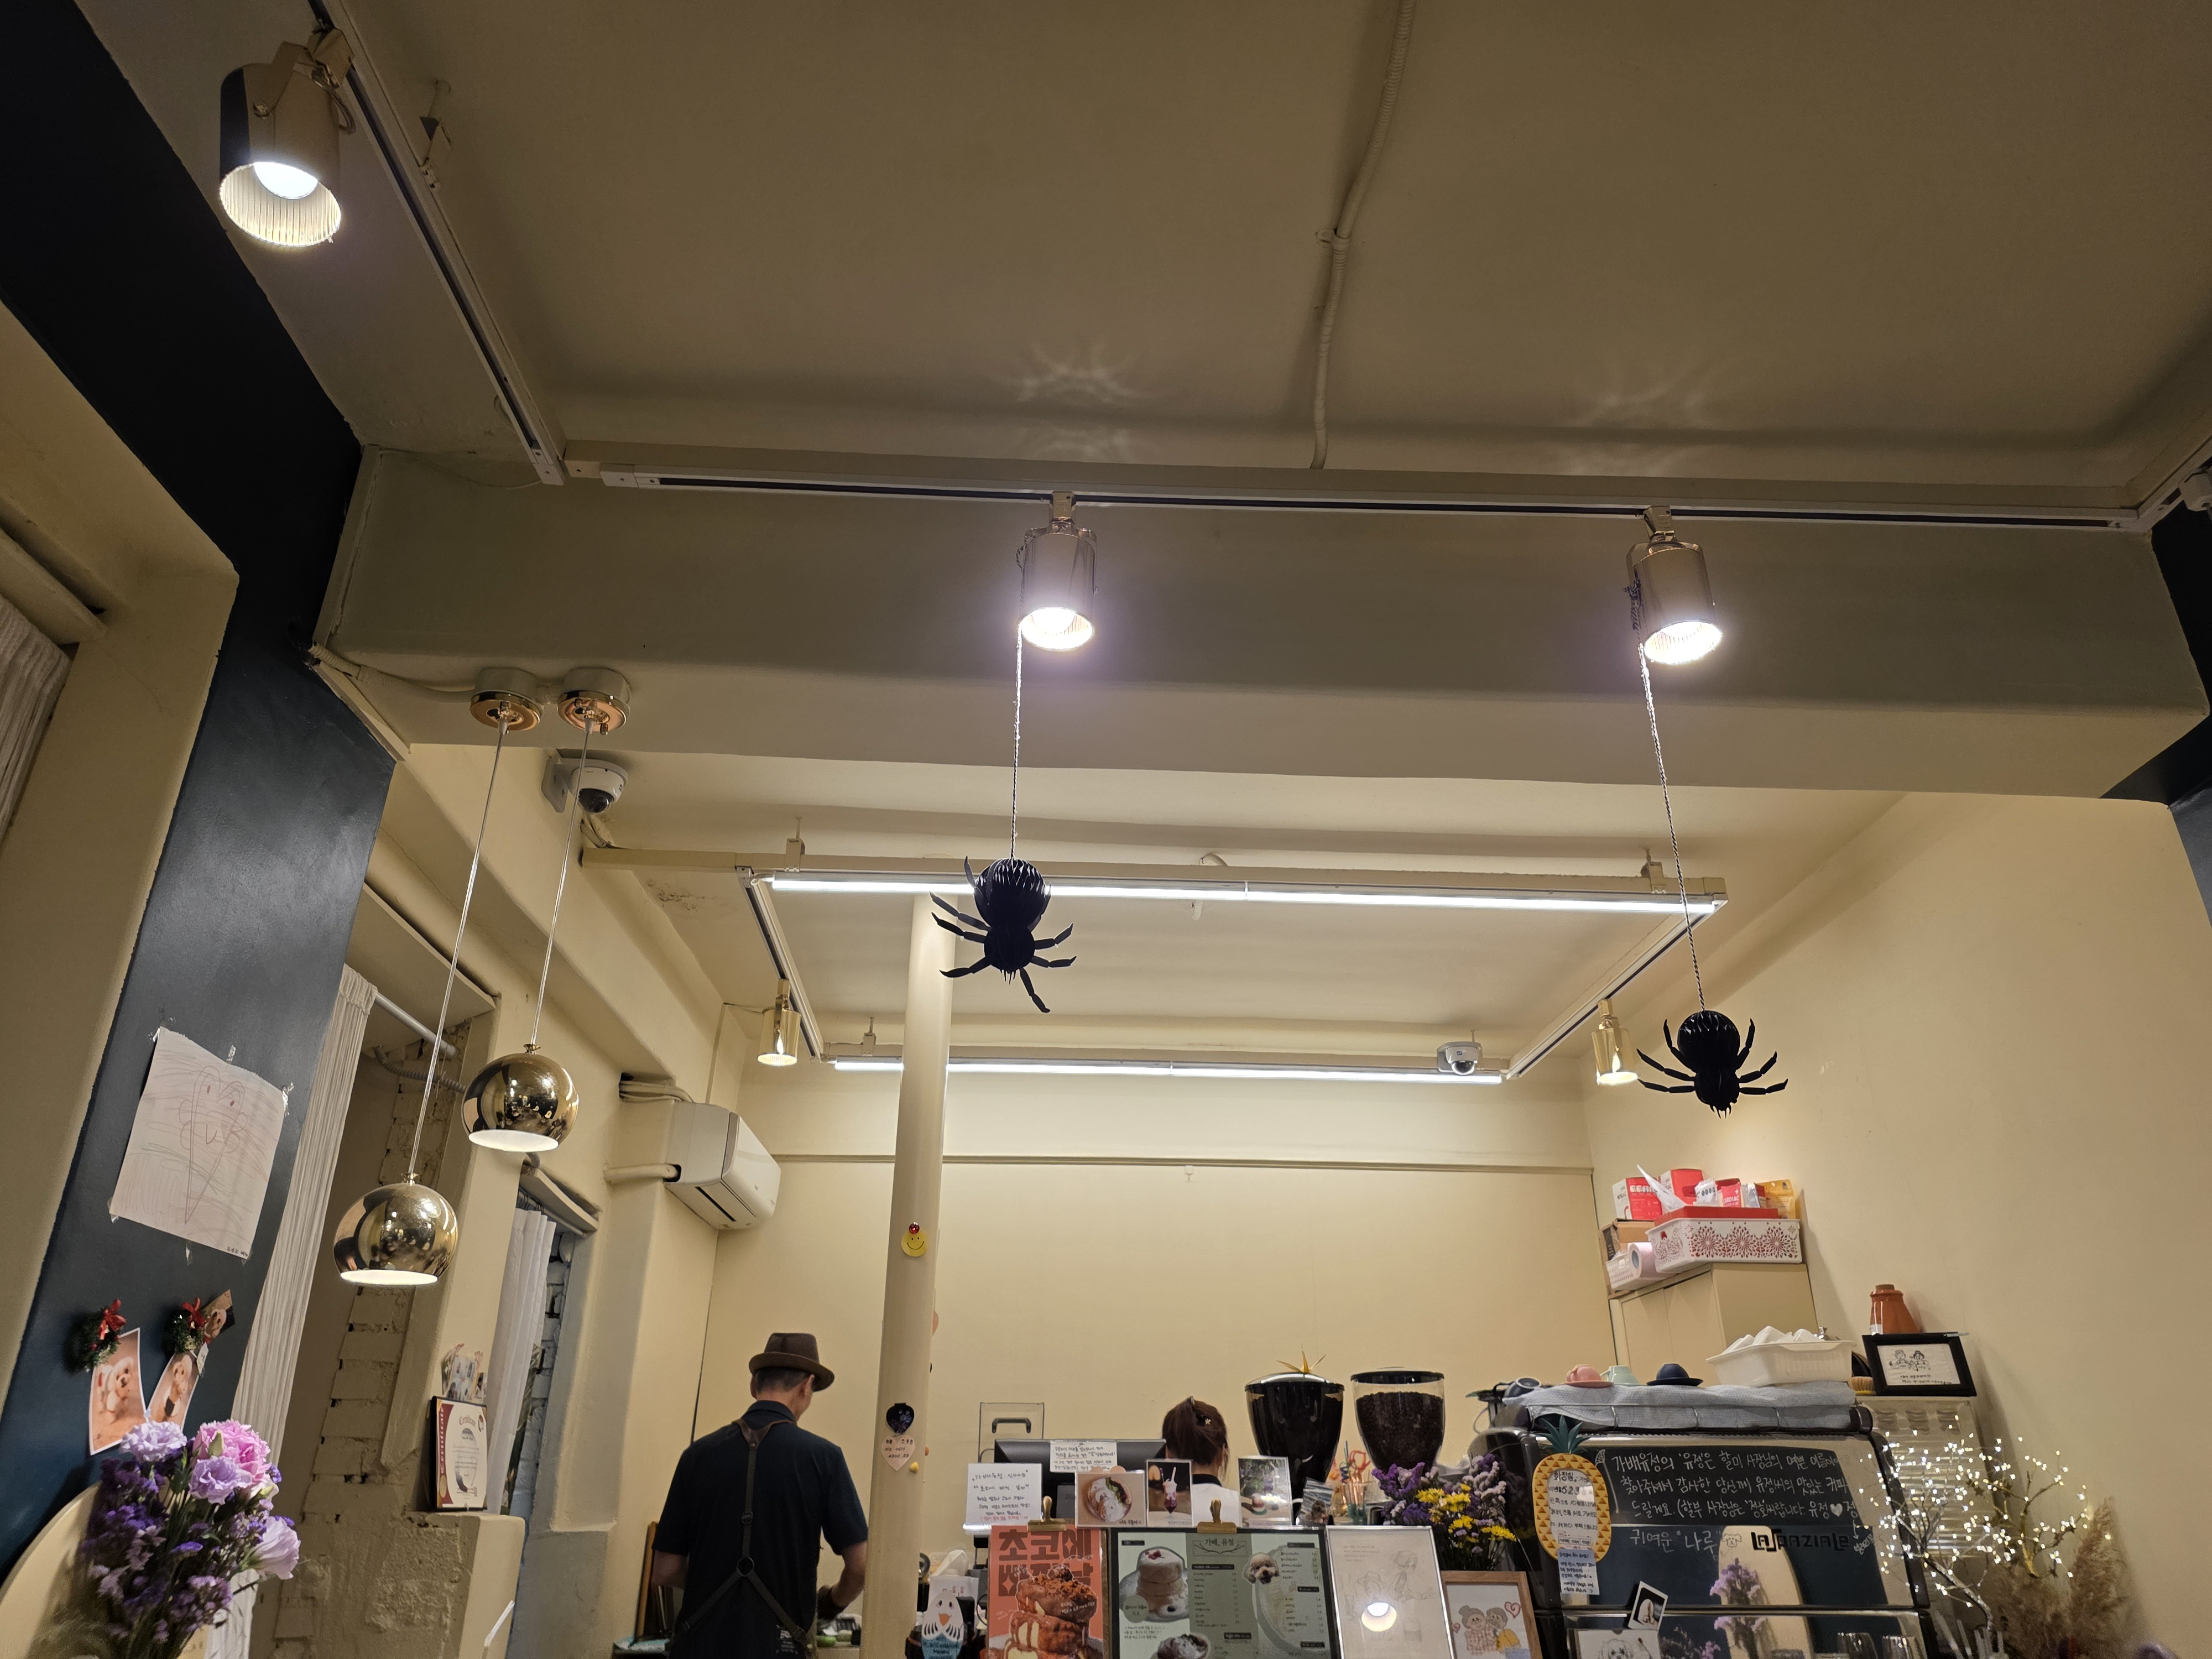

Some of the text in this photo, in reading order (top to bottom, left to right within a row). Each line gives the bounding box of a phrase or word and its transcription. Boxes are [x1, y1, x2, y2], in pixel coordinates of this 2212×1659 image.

[1611, 1452, 1674, 1472] 가배유정의
[1719, 1450, 1743, 1470] 할미
[1746, 1452, 1783, 1469] 사장님의
[1786, 1453, 1808, 1470] 예쁜
[1620, 1475, 1673, 1495] 찾아주셔서
[1676, 1476, 1710, 1493] 감사한
[1716, 1477, 1752, 1493] 당신께
[1756, 1476, 1795, 1494] 유정씨의
[1797, 1476, 1825, 1496] 맛있는
[1632, 1500, 1675, 1519] 드릴게요.
[1707, 1498, 1745, 1517] 사장님은
[999, 1529, 1092, 1561] 초코에
[1222, 1538, 1234, 1546] 유정
[1630, 1529, 1674, 1553] 귀여운
